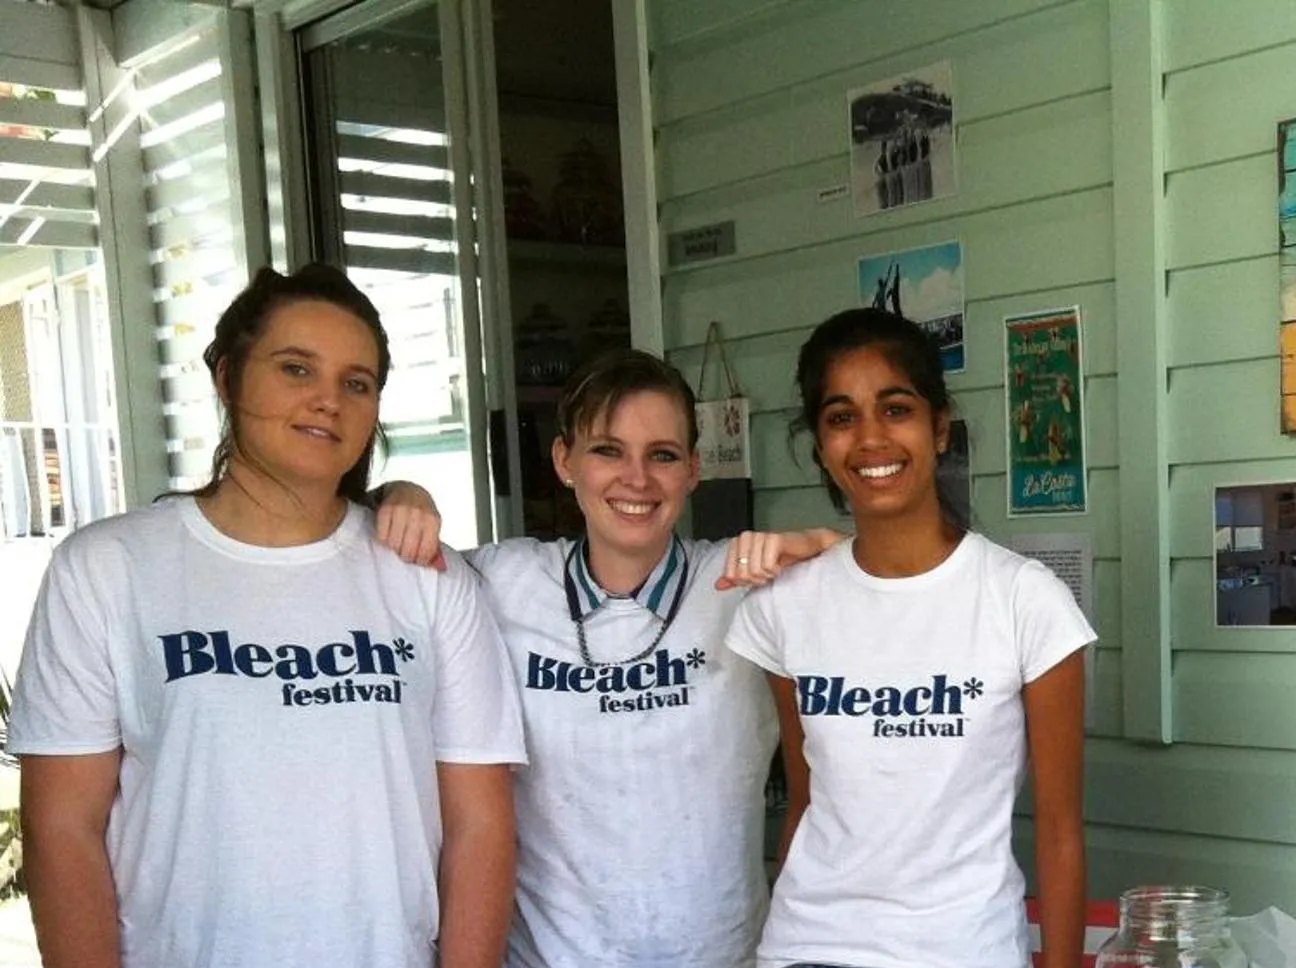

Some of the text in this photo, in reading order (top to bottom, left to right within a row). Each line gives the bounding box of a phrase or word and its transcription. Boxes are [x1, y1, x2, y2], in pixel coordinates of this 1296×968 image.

[282, 678, 402, 707] festival
[599, 687, 690, 713] festival
[873, 718, 966, 738] festival
